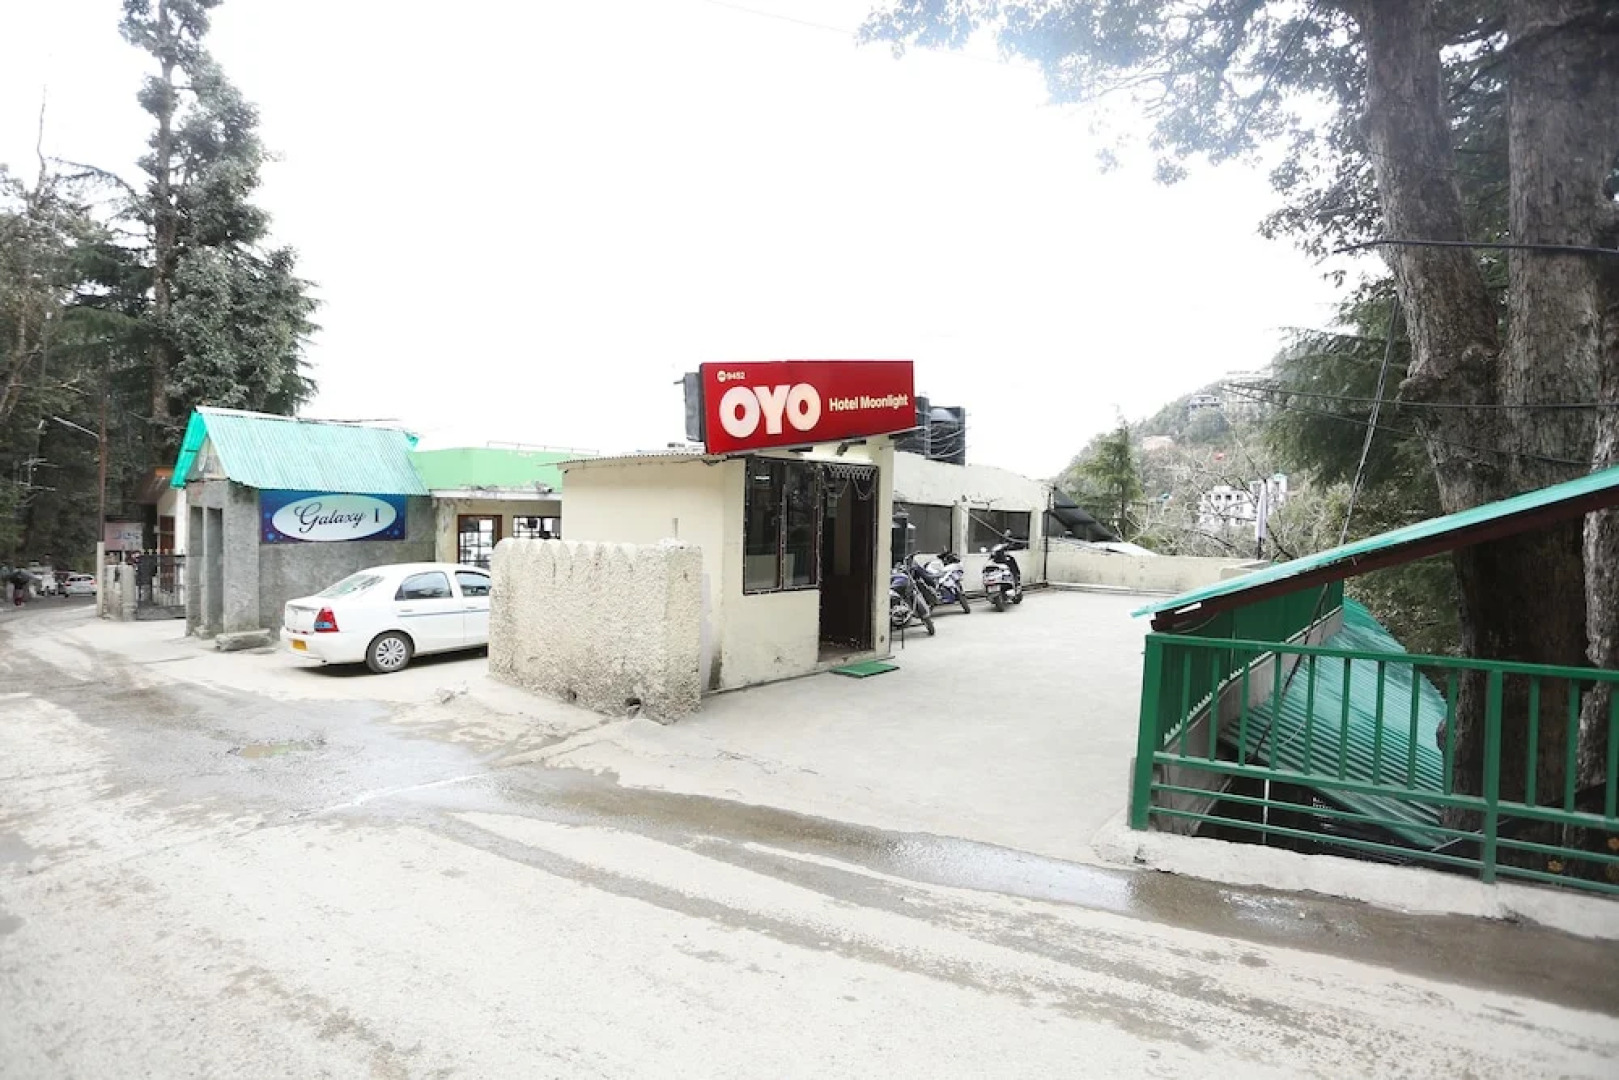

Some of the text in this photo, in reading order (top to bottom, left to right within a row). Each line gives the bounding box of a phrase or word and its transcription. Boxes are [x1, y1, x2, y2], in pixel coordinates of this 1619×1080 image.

[719, 383, 821, 438] OYO
[829, 393, 908, 411] Hotel Moonlight
[294, 502, 366, 533] Galaxy
